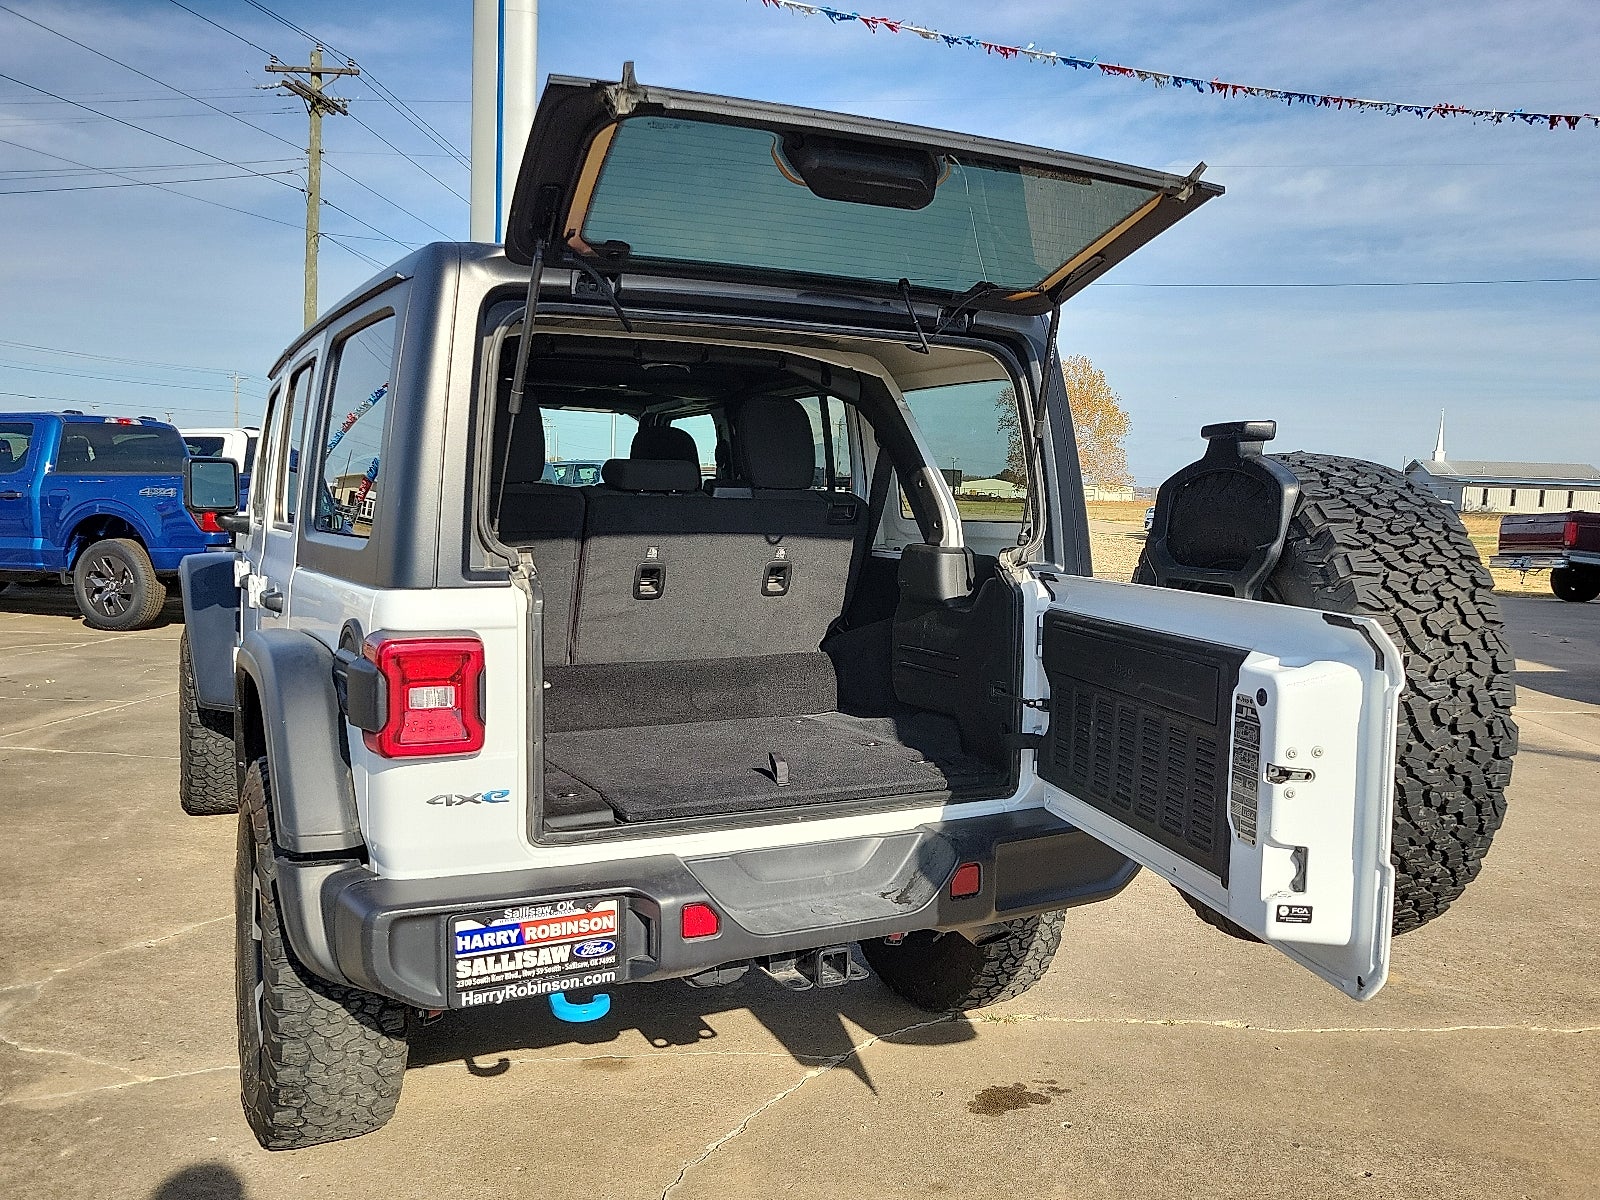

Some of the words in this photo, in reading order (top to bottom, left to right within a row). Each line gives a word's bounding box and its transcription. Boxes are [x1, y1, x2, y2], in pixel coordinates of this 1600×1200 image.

[503, 905, 554, 919] Sallisaw,
[556, 900, 575, 911] OK
[456, 928, 521, 952] HARRY
[525, 915, 615, 941] ROBINSON
[456, 944, 572, 979] SALLISAW
[580, 941, 608, 956] Ford
[473, 976, 491, 985] South
[522, 968, 536, 978] Hwy
[544, 965, 562, 974] South
[461, 971, 616, 1007] HarryRobinson.com
